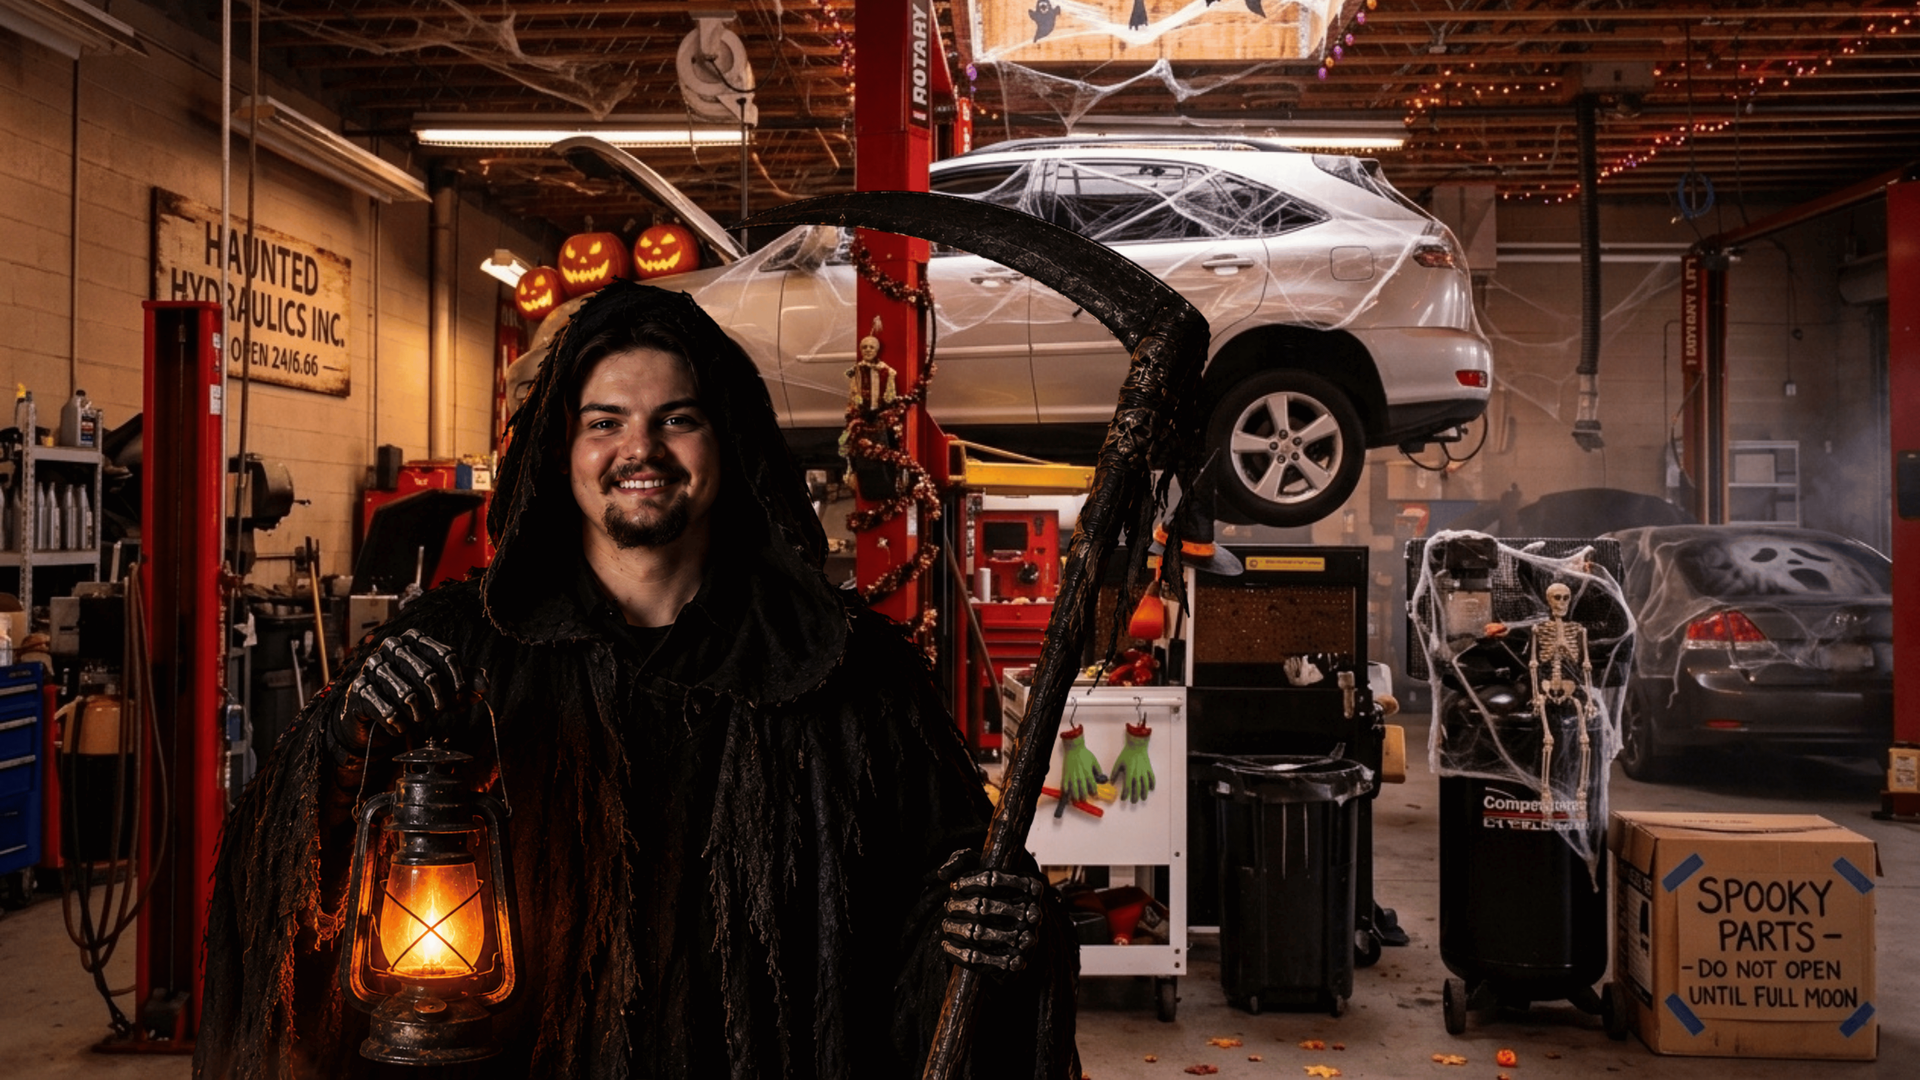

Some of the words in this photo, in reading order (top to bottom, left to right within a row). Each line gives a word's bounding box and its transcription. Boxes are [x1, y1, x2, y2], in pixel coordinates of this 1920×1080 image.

[912, 3, 928, 105] ROTARY
[205, 221, 319, 296] HAUNTED
[312, 306, 346, 348] INC.
[231, 337, 269, 367] OEN
[271, 346, 319, 377] 24/6.66
[1697, 876, 1833, 917] SPOOKY
[1719, 919, 1815, 953] PARTS
[1736, 960, 1777, 979] NOT
[1785, 960, 1841, 980] OPEN
[1689, 986, 1747, 1006] UNTIL
[1754, 986, 1799, 1008] FULL
[1805, 987, 1858, 1009] MOON
